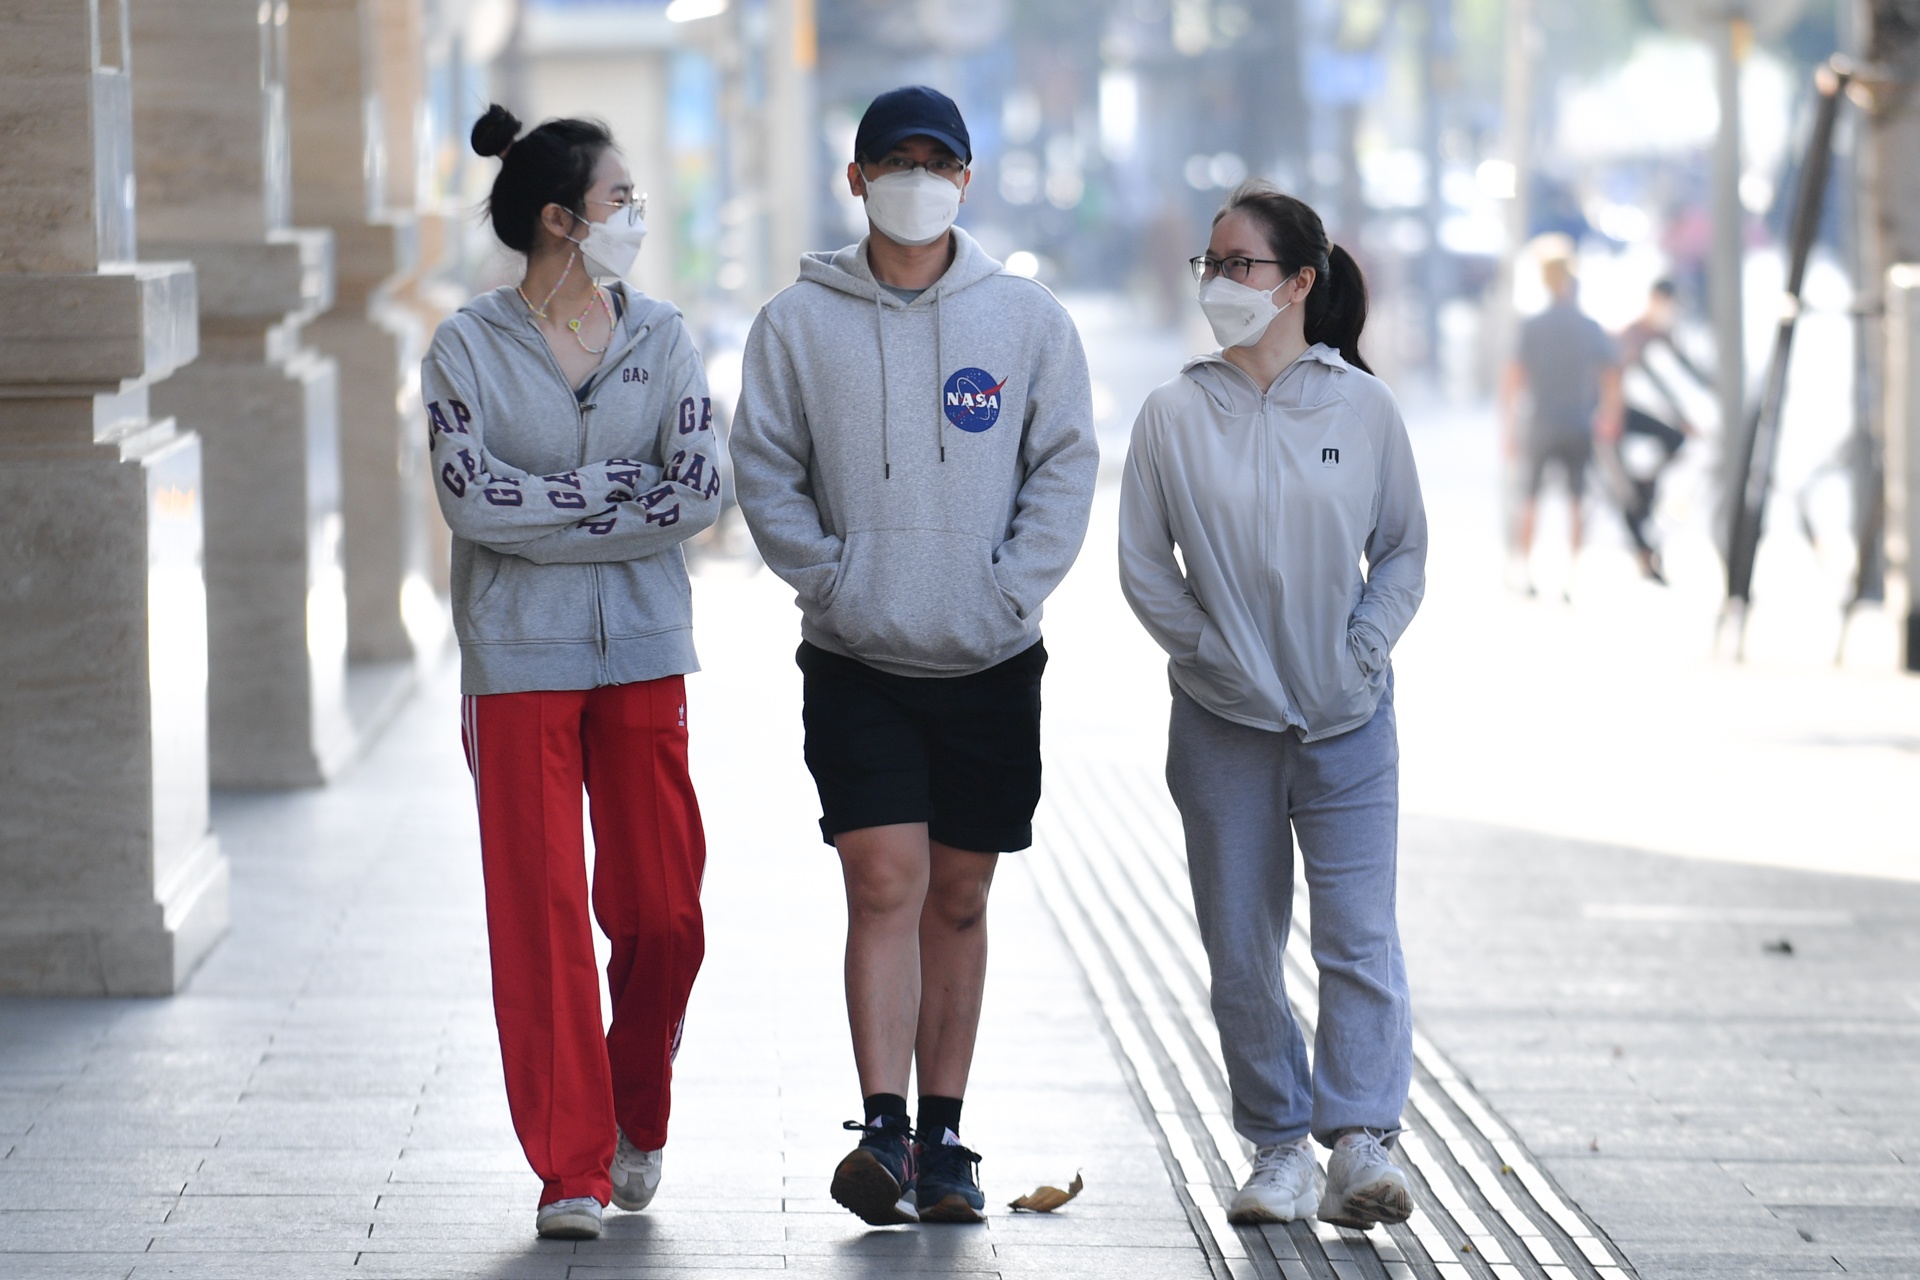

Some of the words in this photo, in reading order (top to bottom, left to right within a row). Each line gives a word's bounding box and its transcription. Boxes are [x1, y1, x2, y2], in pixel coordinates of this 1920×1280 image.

[623, 367, 649, 385] GAP
[678, 396, 714, 436] GA
[946, 391, 999, 410] NASA
[427, 399, 472, 452] AP
[542, 471, 587, 510] GA
[661, 450, 720, 500] GAP
[636, 484, 680, 528] AP
